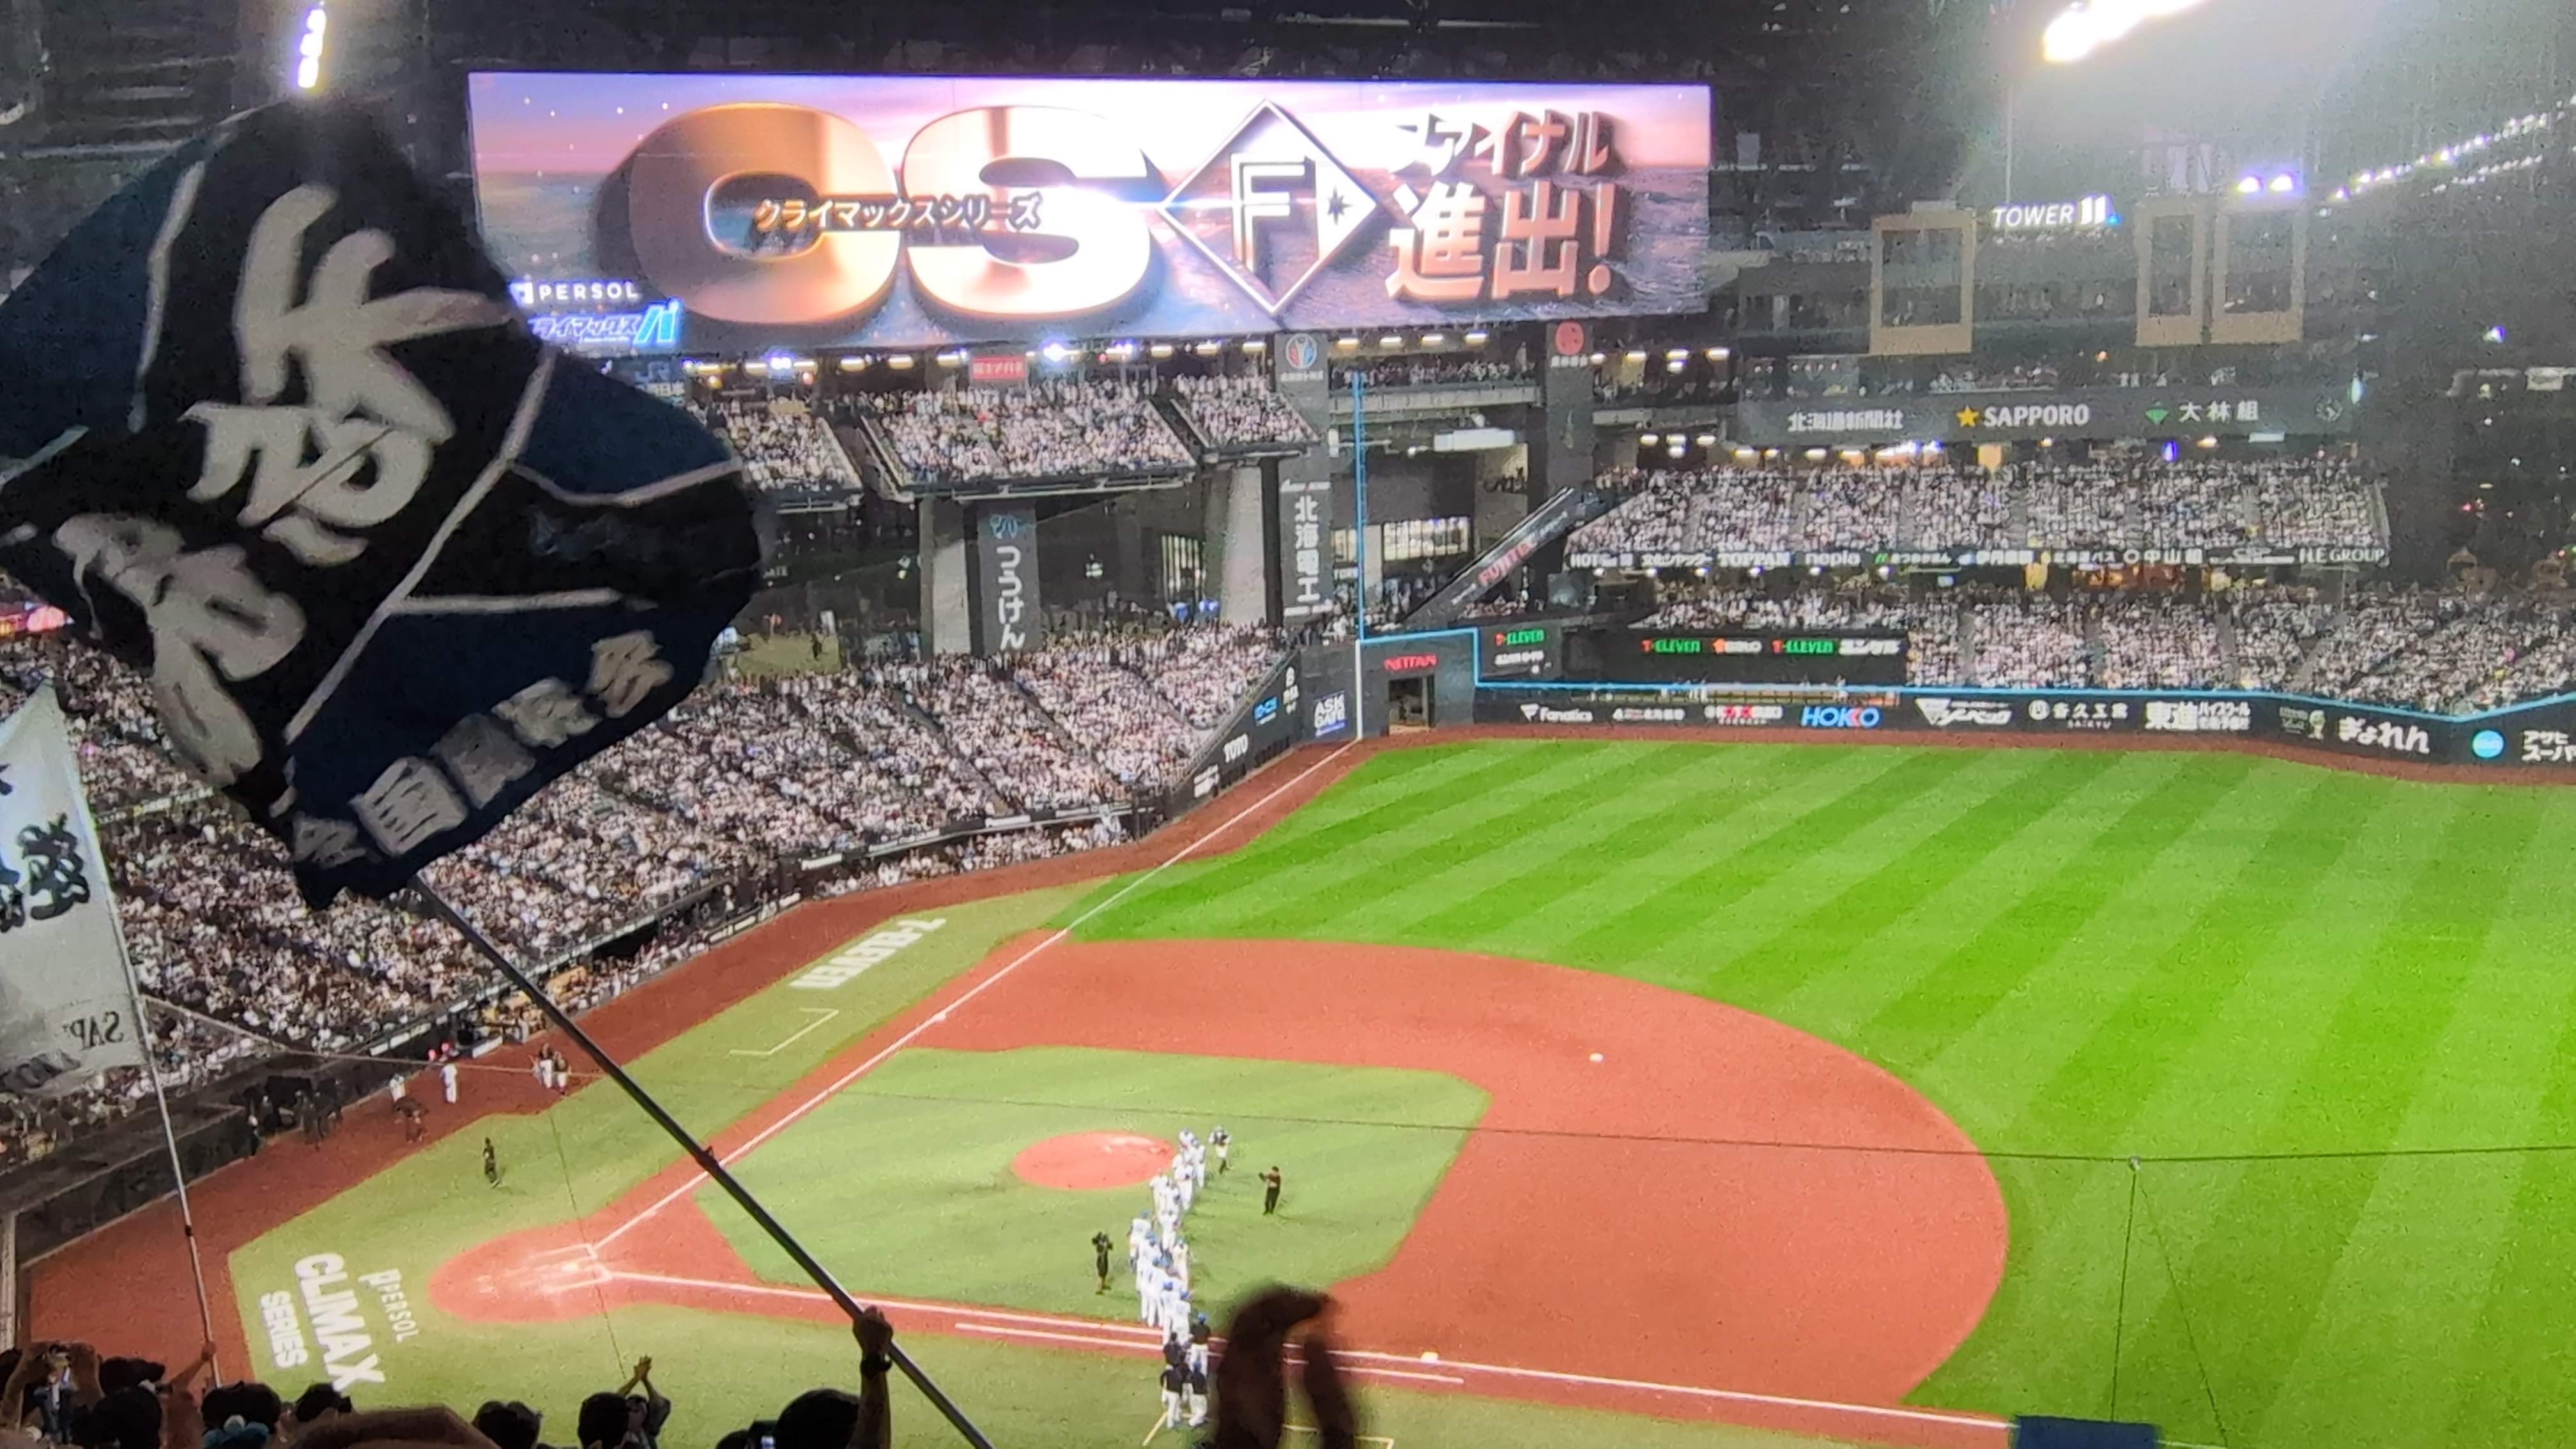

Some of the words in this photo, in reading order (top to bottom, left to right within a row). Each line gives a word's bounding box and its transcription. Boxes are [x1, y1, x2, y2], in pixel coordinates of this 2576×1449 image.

[1390, 109, 1611, 178] ファイナル
[631, 101, 1152, 324] CS
[754, 195, 1043, 231] クライマックスシリーズ
[1993, 204, 2074, 228] TOWER
[2080, 195, 2107, 226] 11
[539, 281, 641, 301] PERSOL
[1984, 404, 2090, 427] SAPPORO
[2178, 400, 2260, 423] 大林組
[1294, 494, 1321, 602] 北海電工
[1718, 552, 1790, 569] TOPPAN
[2329, 548, 2385, 563] GROUP
[995, 545, 1025, 651] つうけん
[1801, 705, 1880, 727] HOKKO
[2145, 701, 2198, 730] 東進
[2338, 716, 2430, 755] ぎょれん
[295, 1252, 386, 1392] CLIMAX
[378, 1278, 420, 1343] PERSOL
[260, 1290, 309, 1369] SERIES
